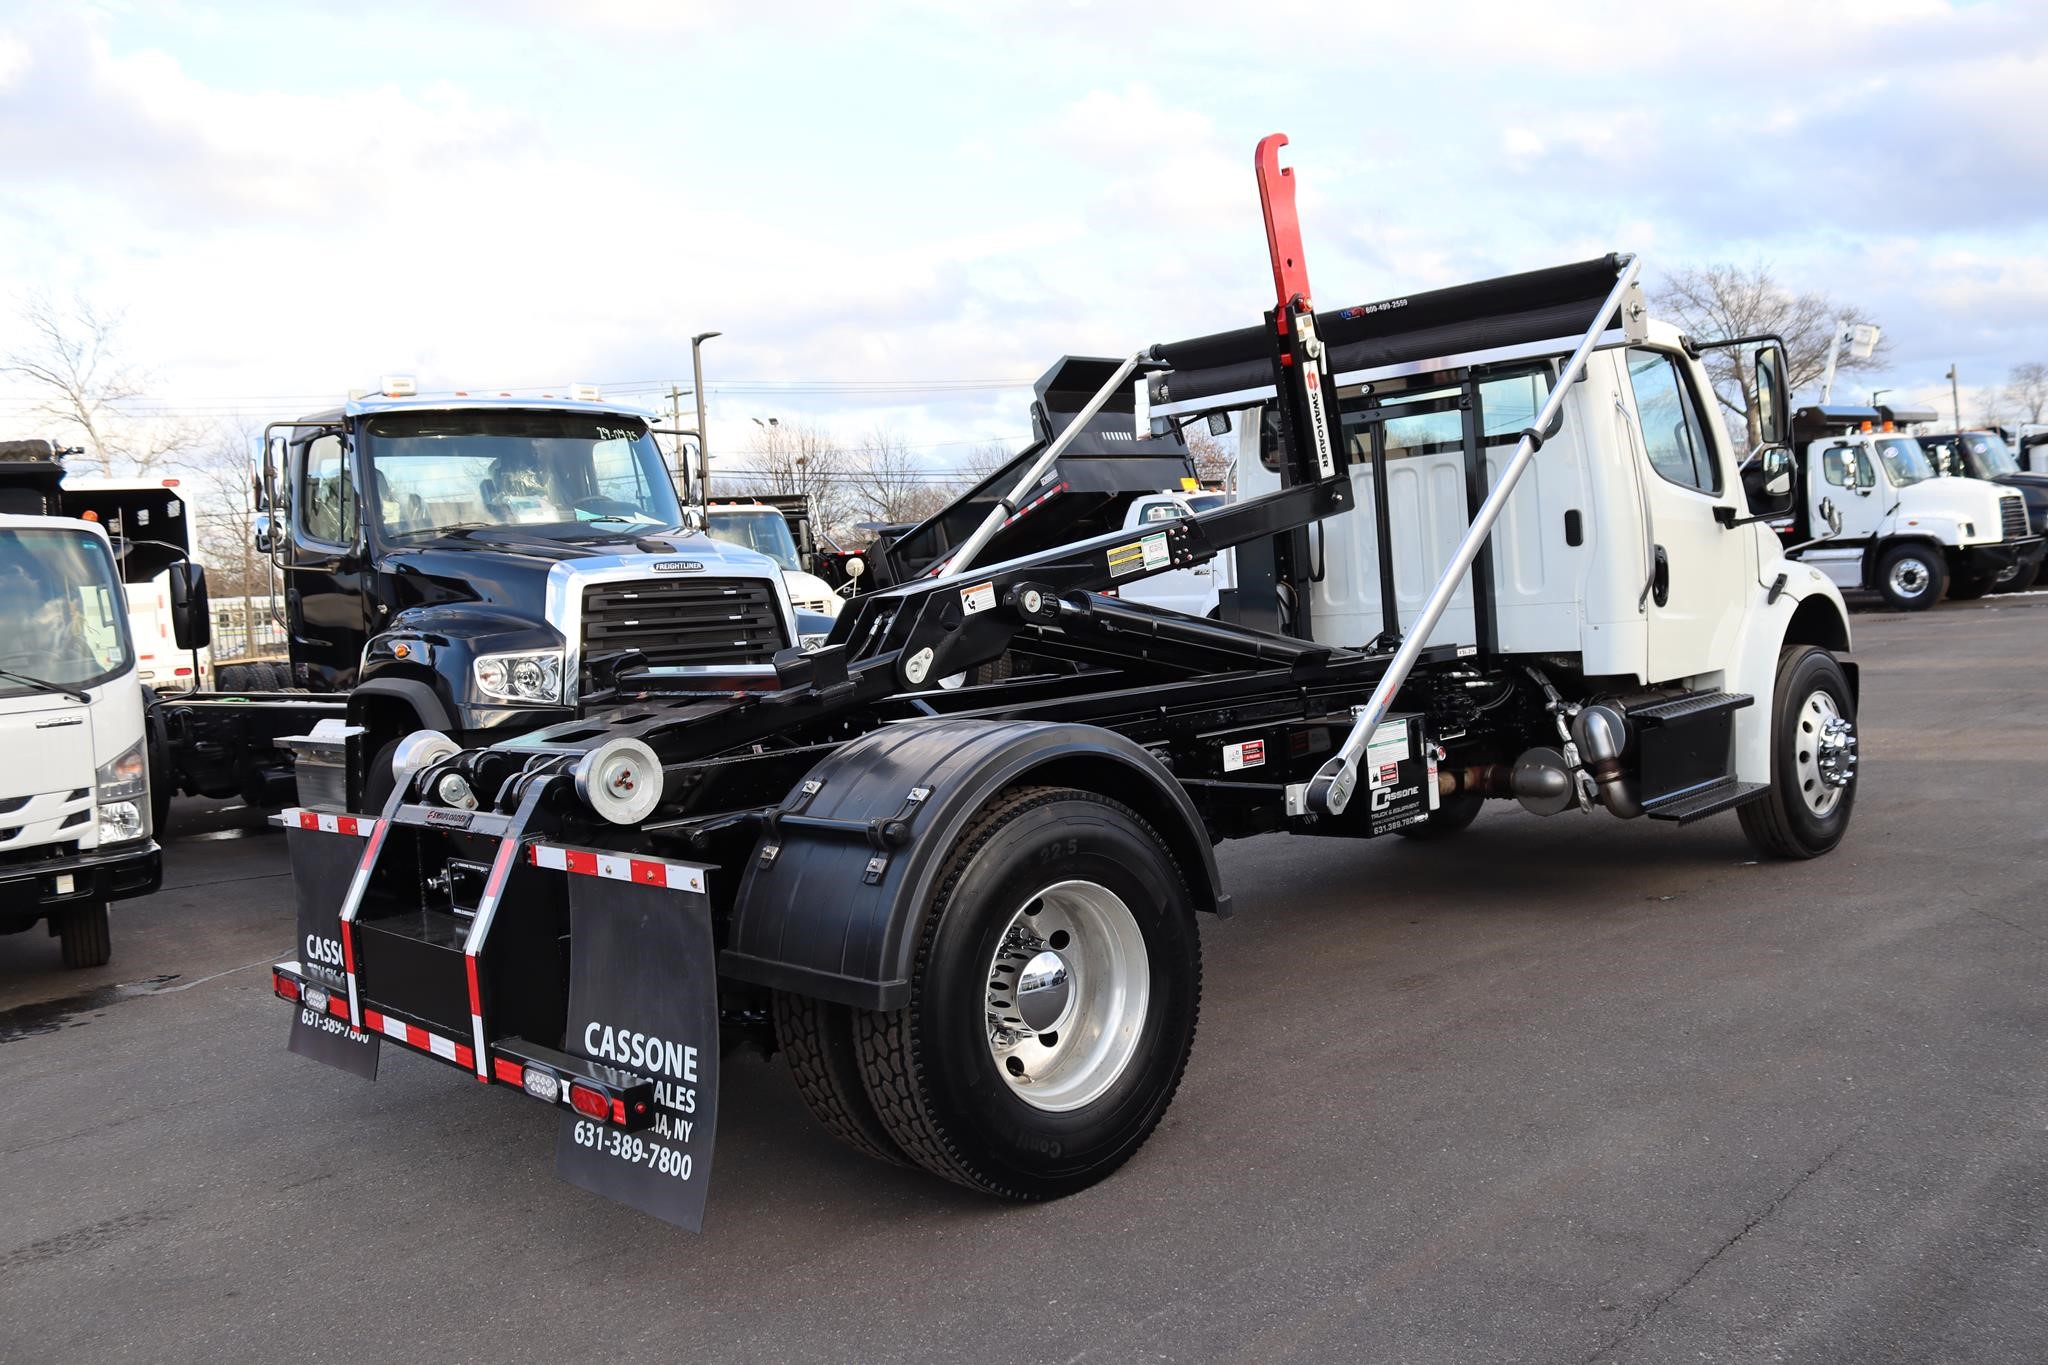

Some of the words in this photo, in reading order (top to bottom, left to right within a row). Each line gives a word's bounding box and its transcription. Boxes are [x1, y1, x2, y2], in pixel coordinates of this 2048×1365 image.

[1311, 393, 1329, 468] SWAPLOADER
[655, 562, 702, 570] FREIGHTLINER
[1371, 811, 1389, 820] TRUCK
[1373, 815, 1418, 835] 631.389.780
[306, 934, 344, 967] CASS
[584, 1021, 698, 1083] CASSONE
[645, 1077, 696, 1114] ALES
[673, 1117, 694, 1143] NY
[573, 1120, 692, 1181] 631-389-7800
